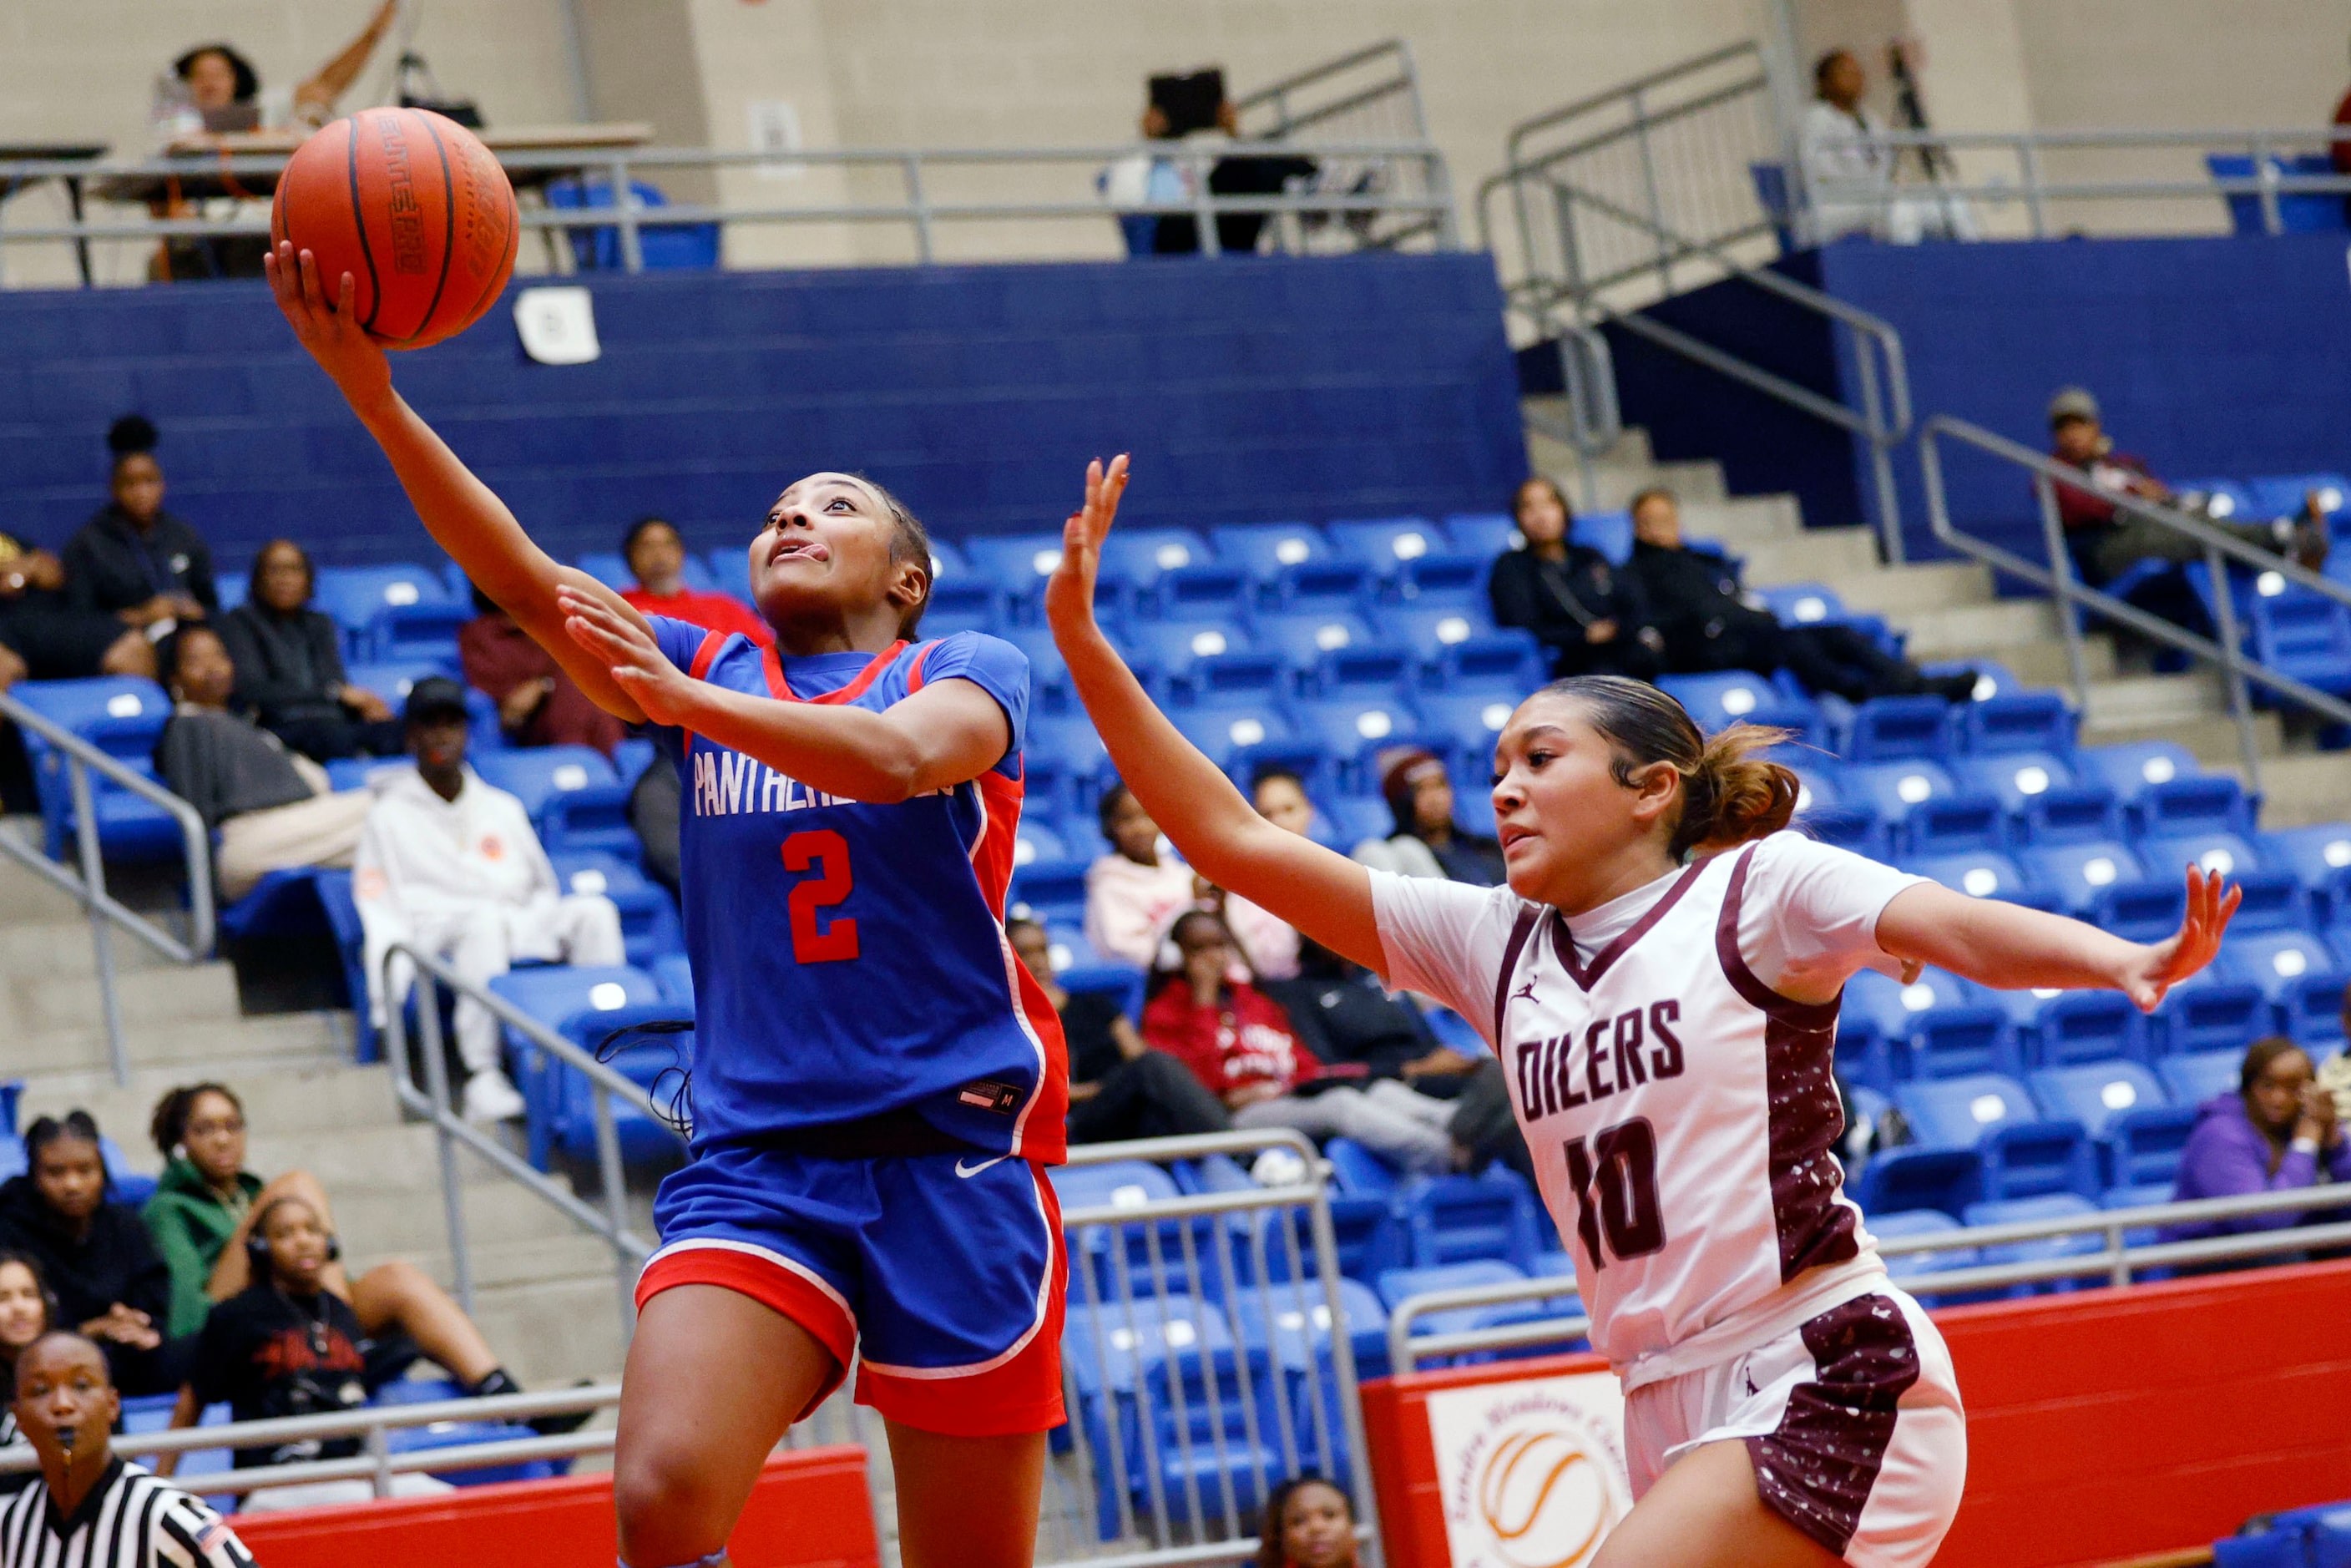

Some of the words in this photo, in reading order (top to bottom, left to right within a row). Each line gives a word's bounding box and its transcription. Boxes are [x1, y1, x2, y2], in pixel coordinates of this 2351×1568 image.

[780, 827, 861, 965] 2
[1000, 1093, 1014, 1107] M
[1516, 998, 1685, 1123] OILERS
[1563, 1115, 1667, 1273] 10
